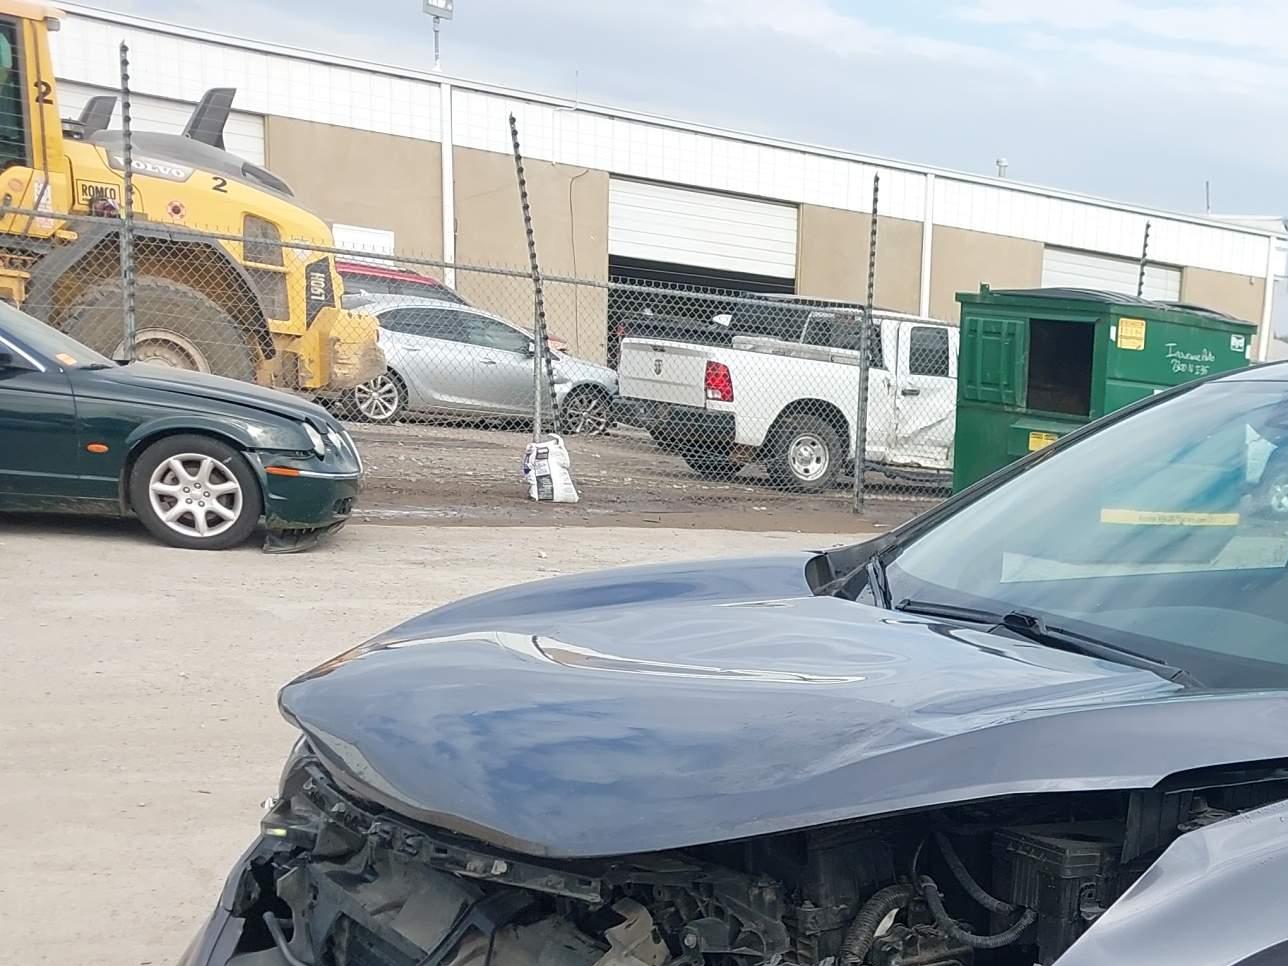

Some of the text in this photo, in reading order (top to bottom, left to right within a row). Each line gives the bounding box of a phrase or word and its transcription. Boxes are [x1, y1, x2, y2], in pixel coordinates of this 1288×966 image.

[33, 80, 54, 105] 2
[81, 183, 117, 200] ROMCO
[211, 176, 229, 194] 2
[310, 271, 326, 301] L90H
